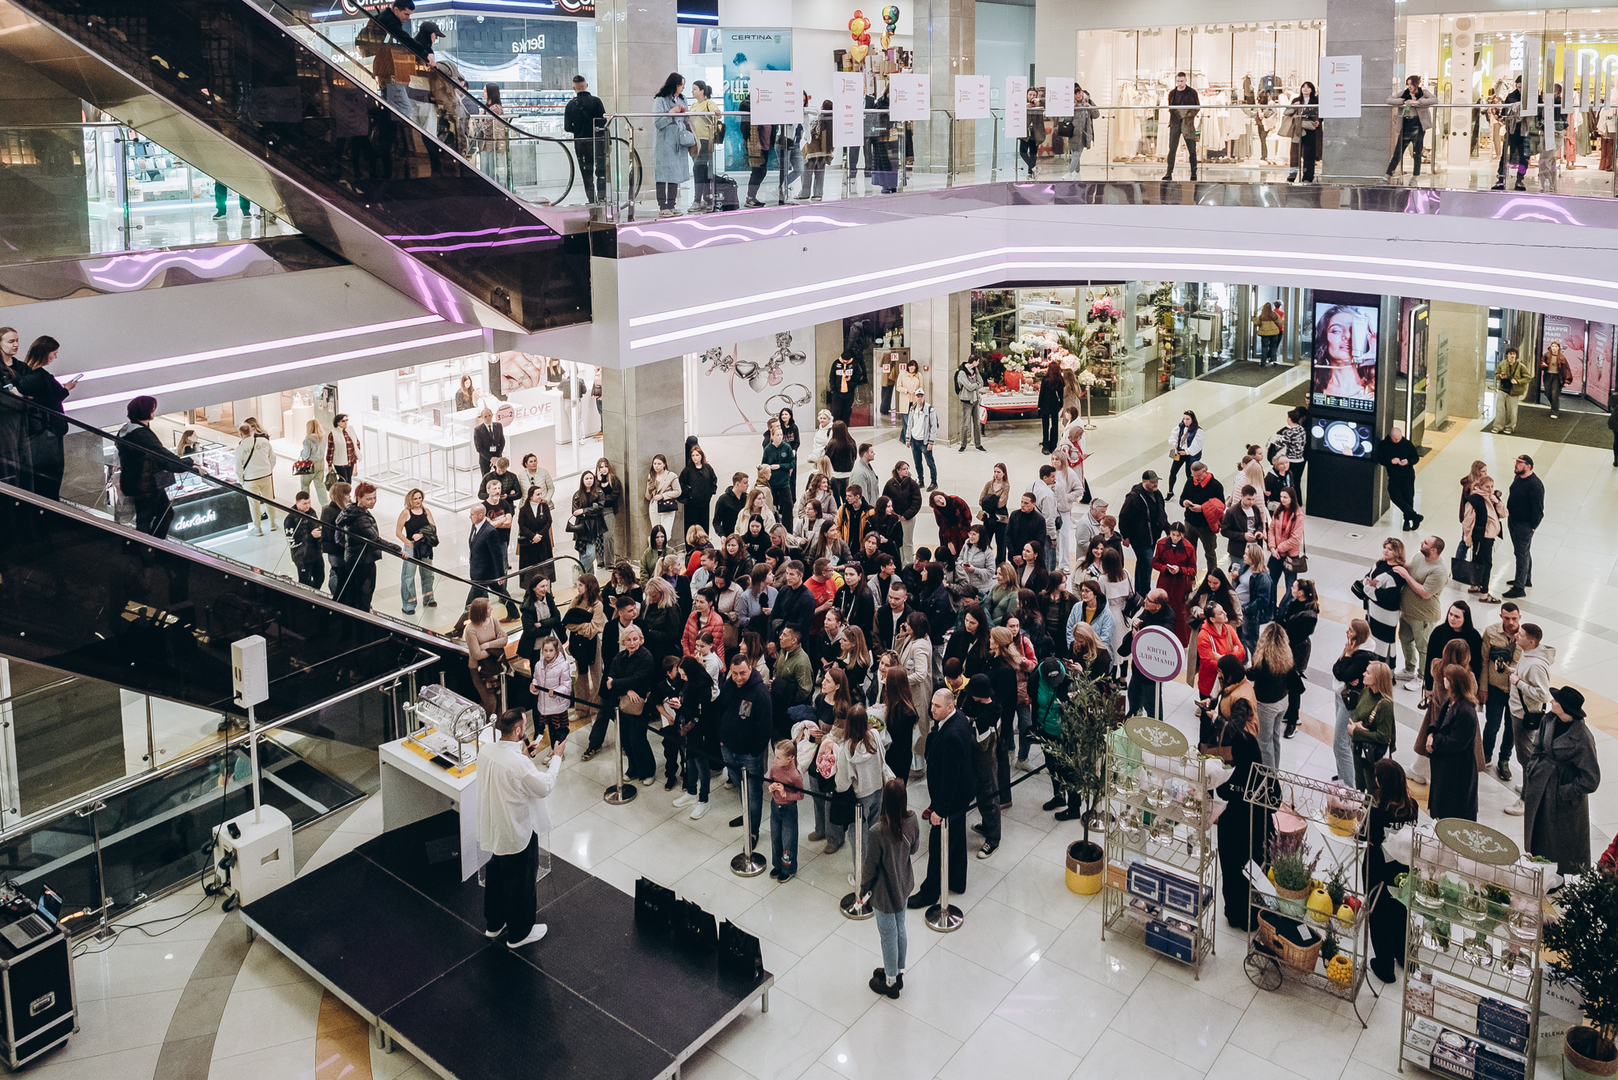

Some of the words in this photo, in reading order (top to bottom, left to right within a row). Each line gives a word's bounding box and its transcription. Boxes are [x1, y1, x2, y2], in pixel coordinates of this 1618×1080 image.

[1146, 645, 1167, 656] КВІТИ
[1138, 652, 1153, 661] ДЛЯ
[1154, 656, 1175, 667] МАМИ
[1545, 989, 1575, 1005] ZELENA
[1540, 1030, 1565, 1038] ZELENA
